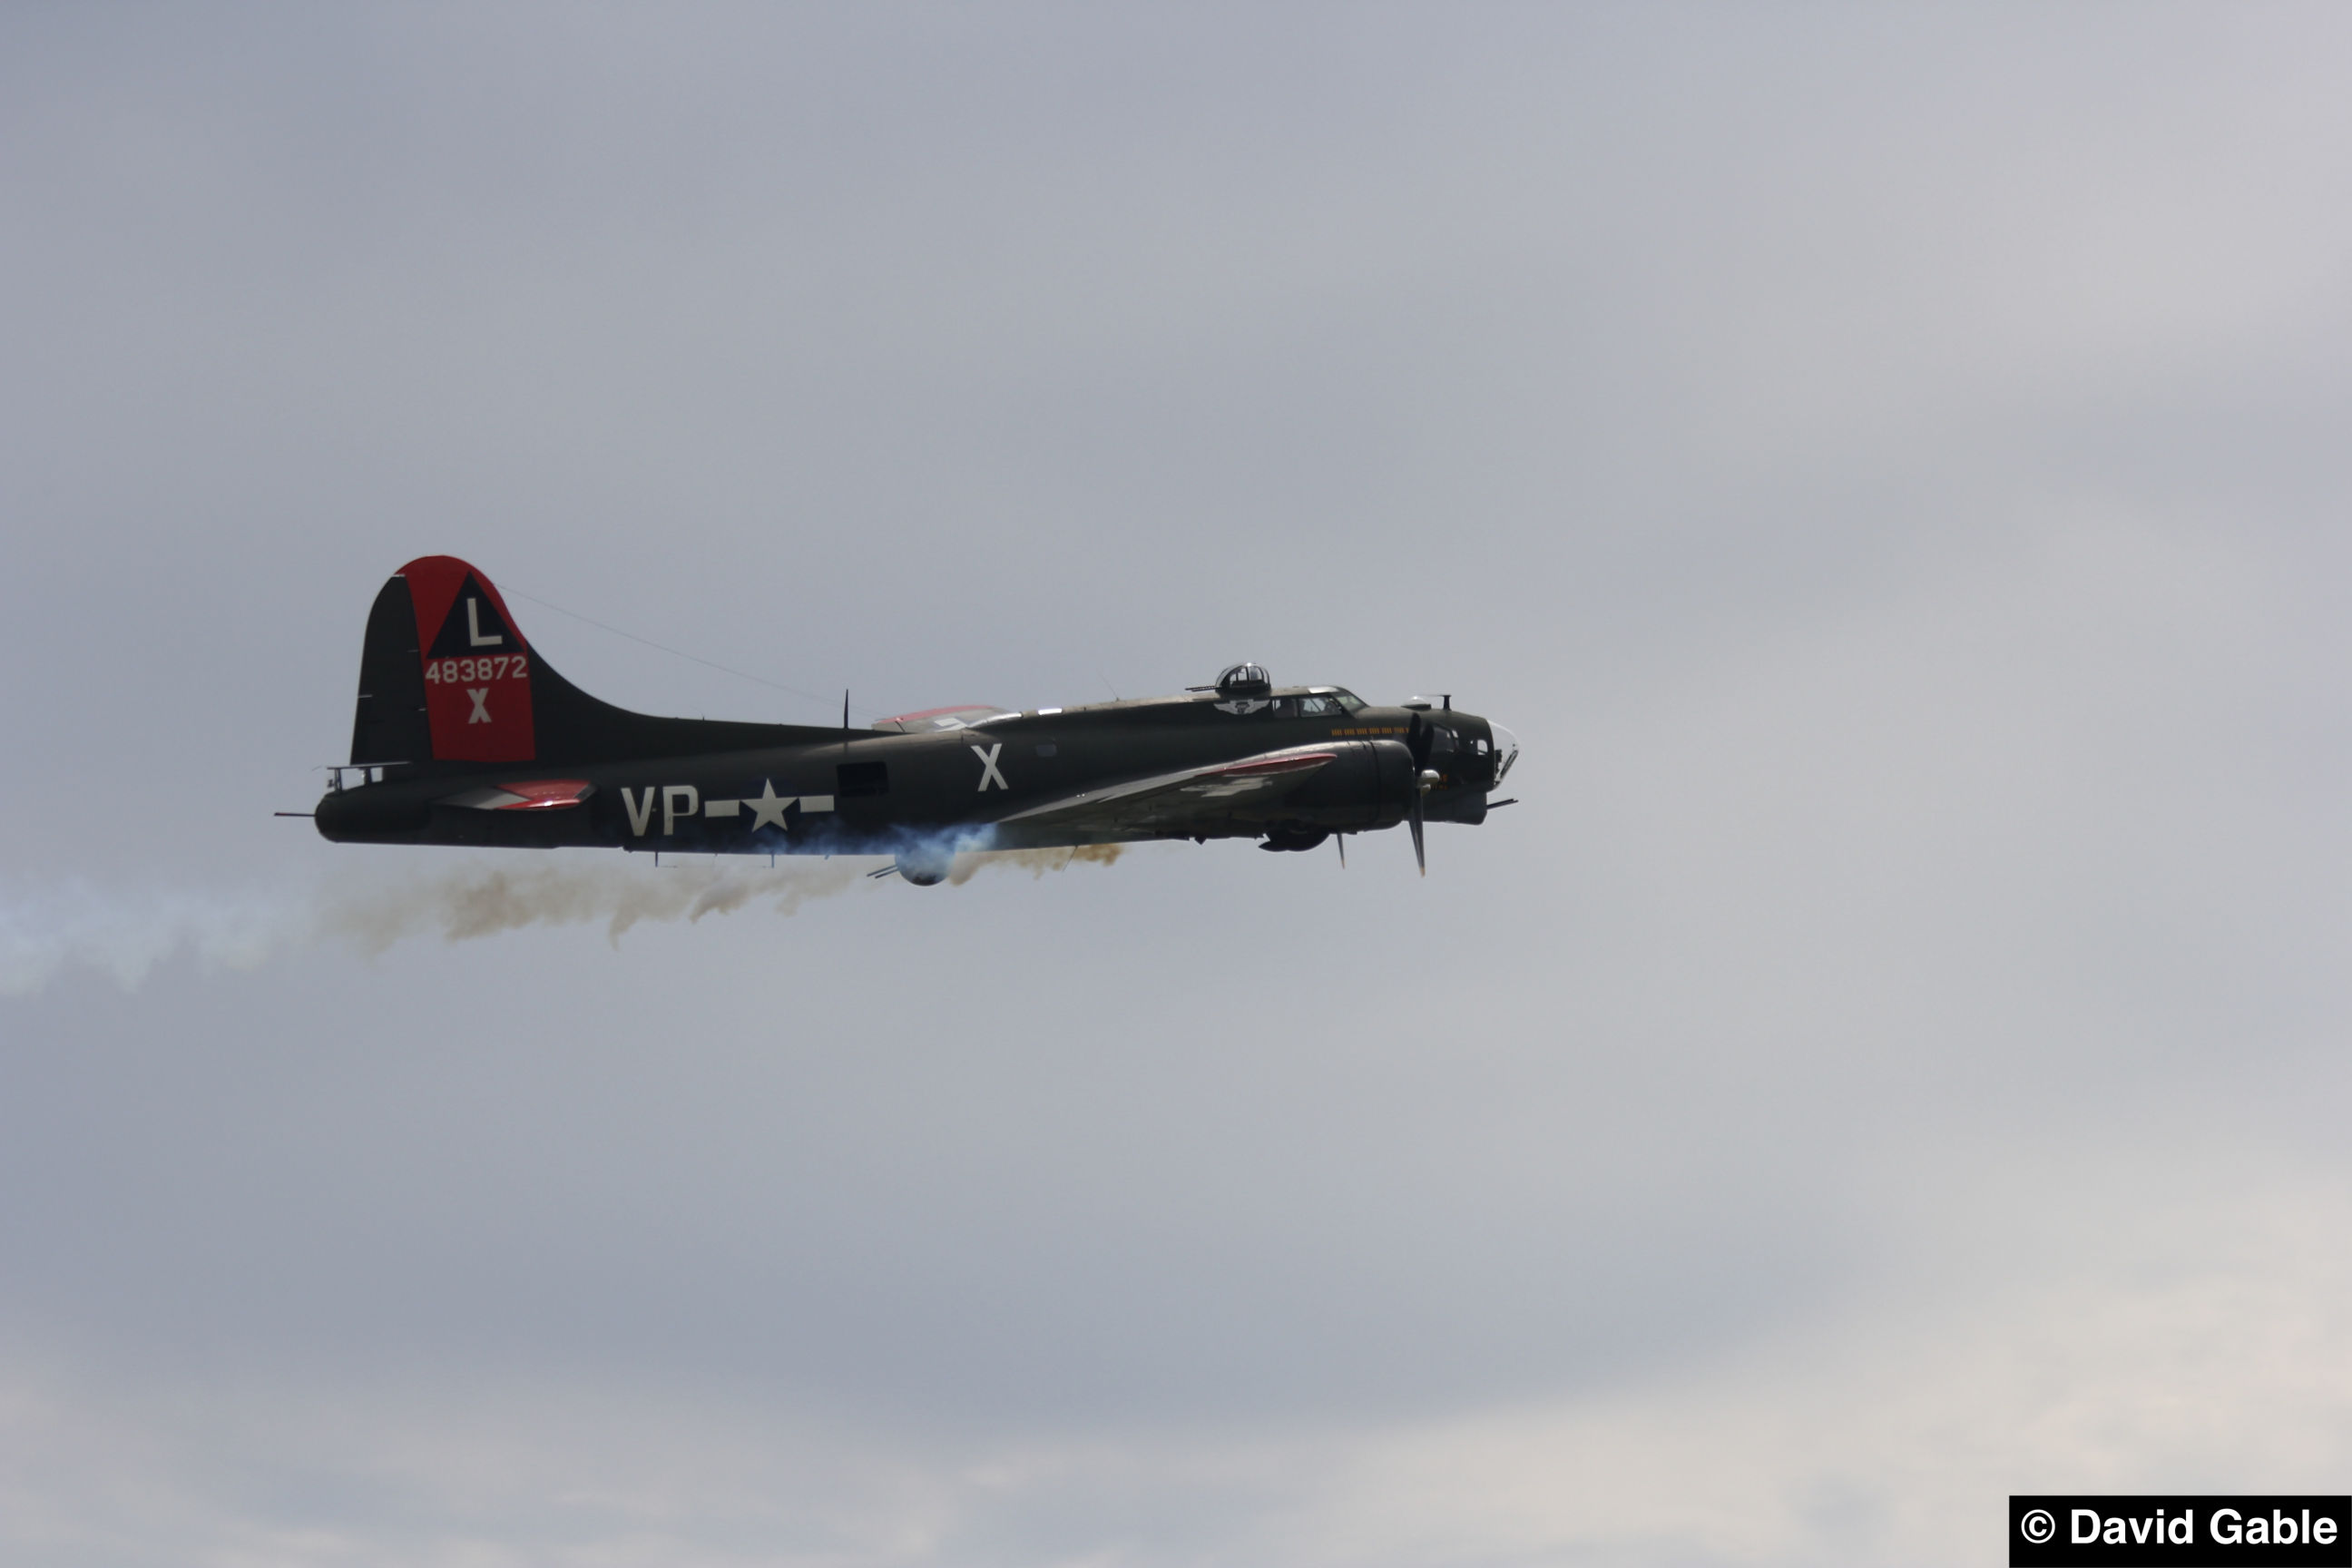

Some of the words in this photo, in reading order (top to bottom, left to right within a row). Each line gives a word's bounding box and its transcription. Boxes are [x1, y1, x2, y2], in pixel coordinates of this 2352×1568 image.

[466, 598, 503, 646] L
[426, 656, 527, 684] 483872
[466, 688, 492, 724] X
[970, 742, 1009, 792] X
[621, 785, 699, 837] VP
